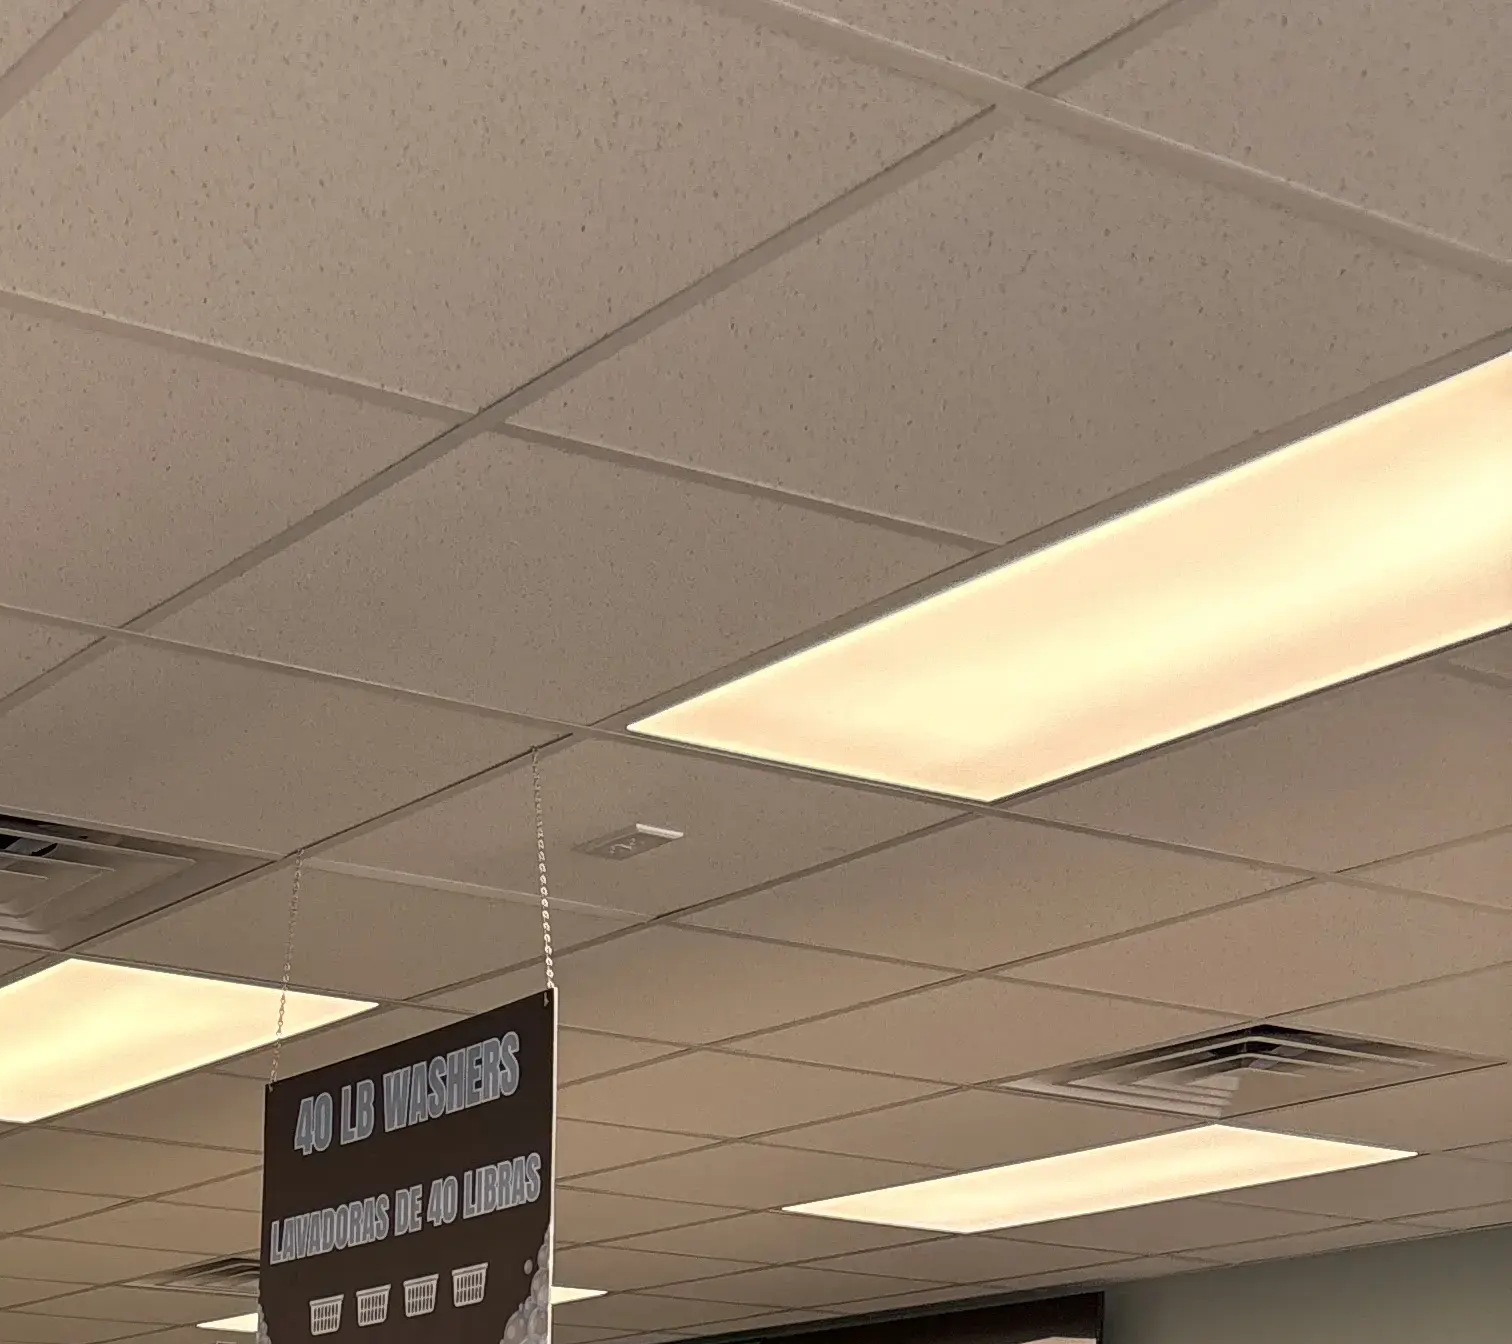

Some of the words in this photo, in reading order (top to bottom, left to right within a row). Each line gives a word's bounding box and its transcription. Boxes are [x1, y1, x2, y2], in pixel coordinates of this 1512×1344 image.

[294, 1092, 333, 1155] 40
[340, 1079, 375, 1145] LB
[383, 1031, 519, 1132] WASHERS
[270, 1194, 389, 1264] LAVADORAS
[394, 1184, 422, 1236] DE
[427, 1175, 458, 1226] 40
[463, 1152, 541, 1219] LIBRAS
